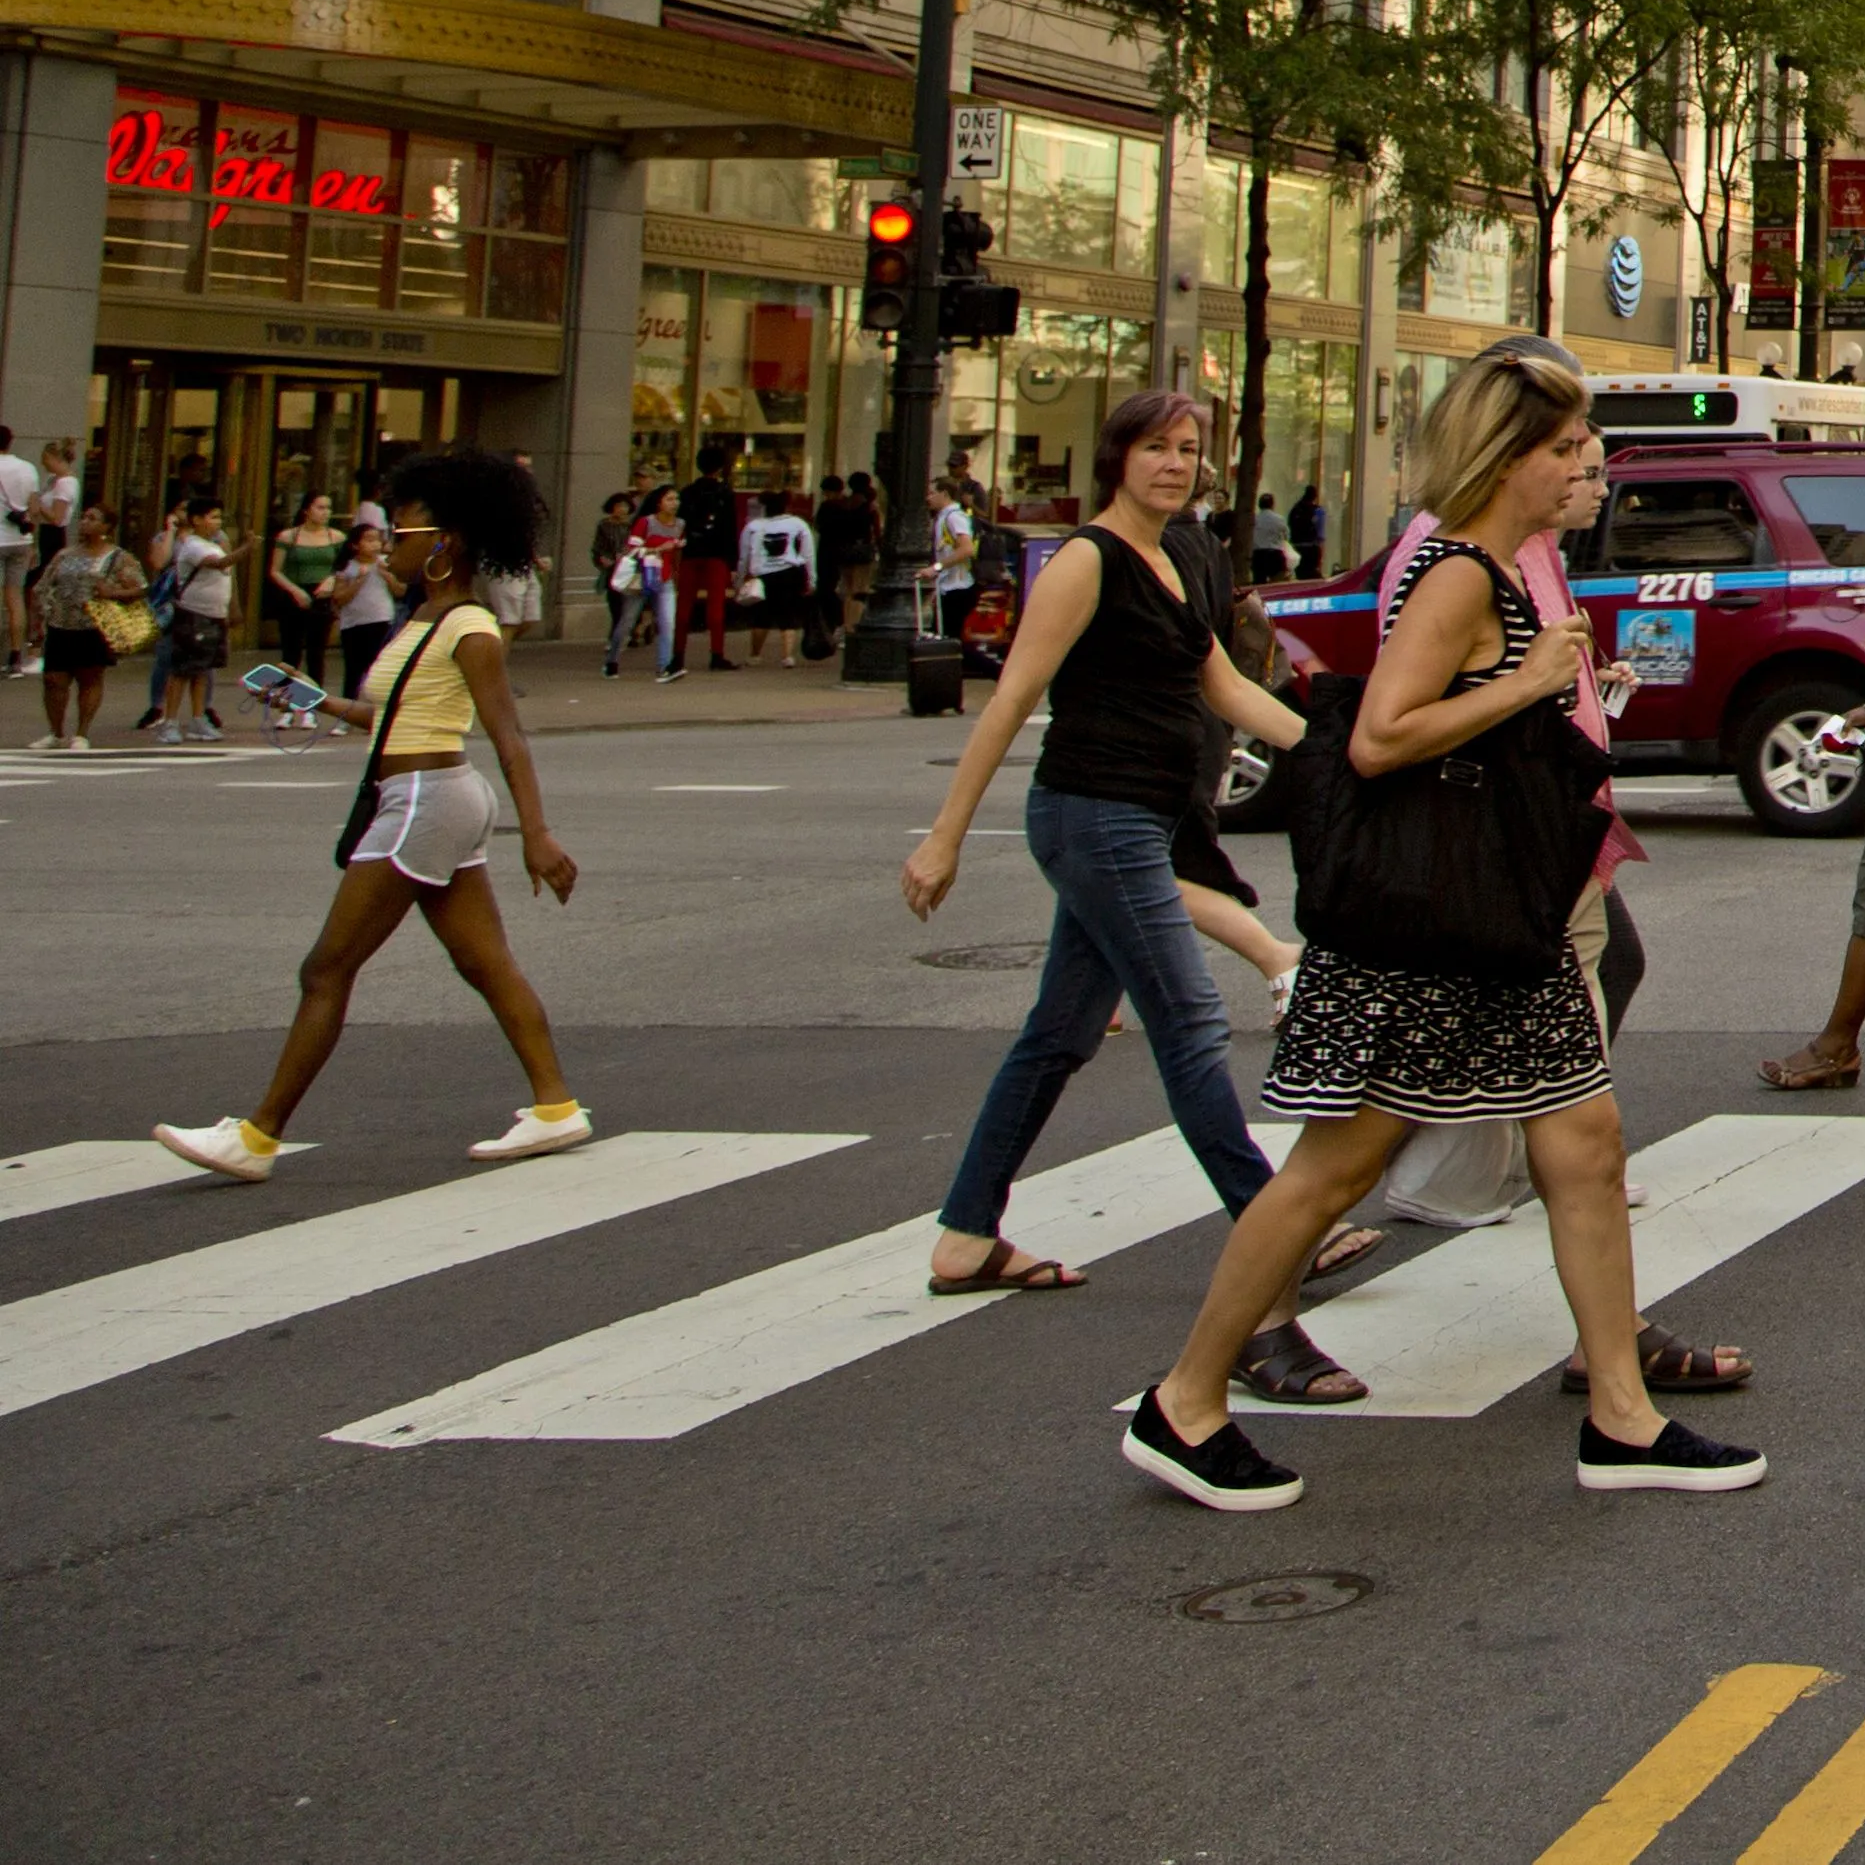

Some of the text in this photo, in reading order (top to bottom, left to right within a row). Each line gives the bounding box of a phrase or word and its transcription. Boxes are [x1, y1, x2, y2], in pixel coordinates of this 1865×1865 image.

[958, 112, 998, 130] ONE
[956, 132, 997, 150] WAY
[264, 322, 305, 346] TWO
[1695, 302, 1708, 358] AT&T
[1636, 571, 1715, 603] 2276
